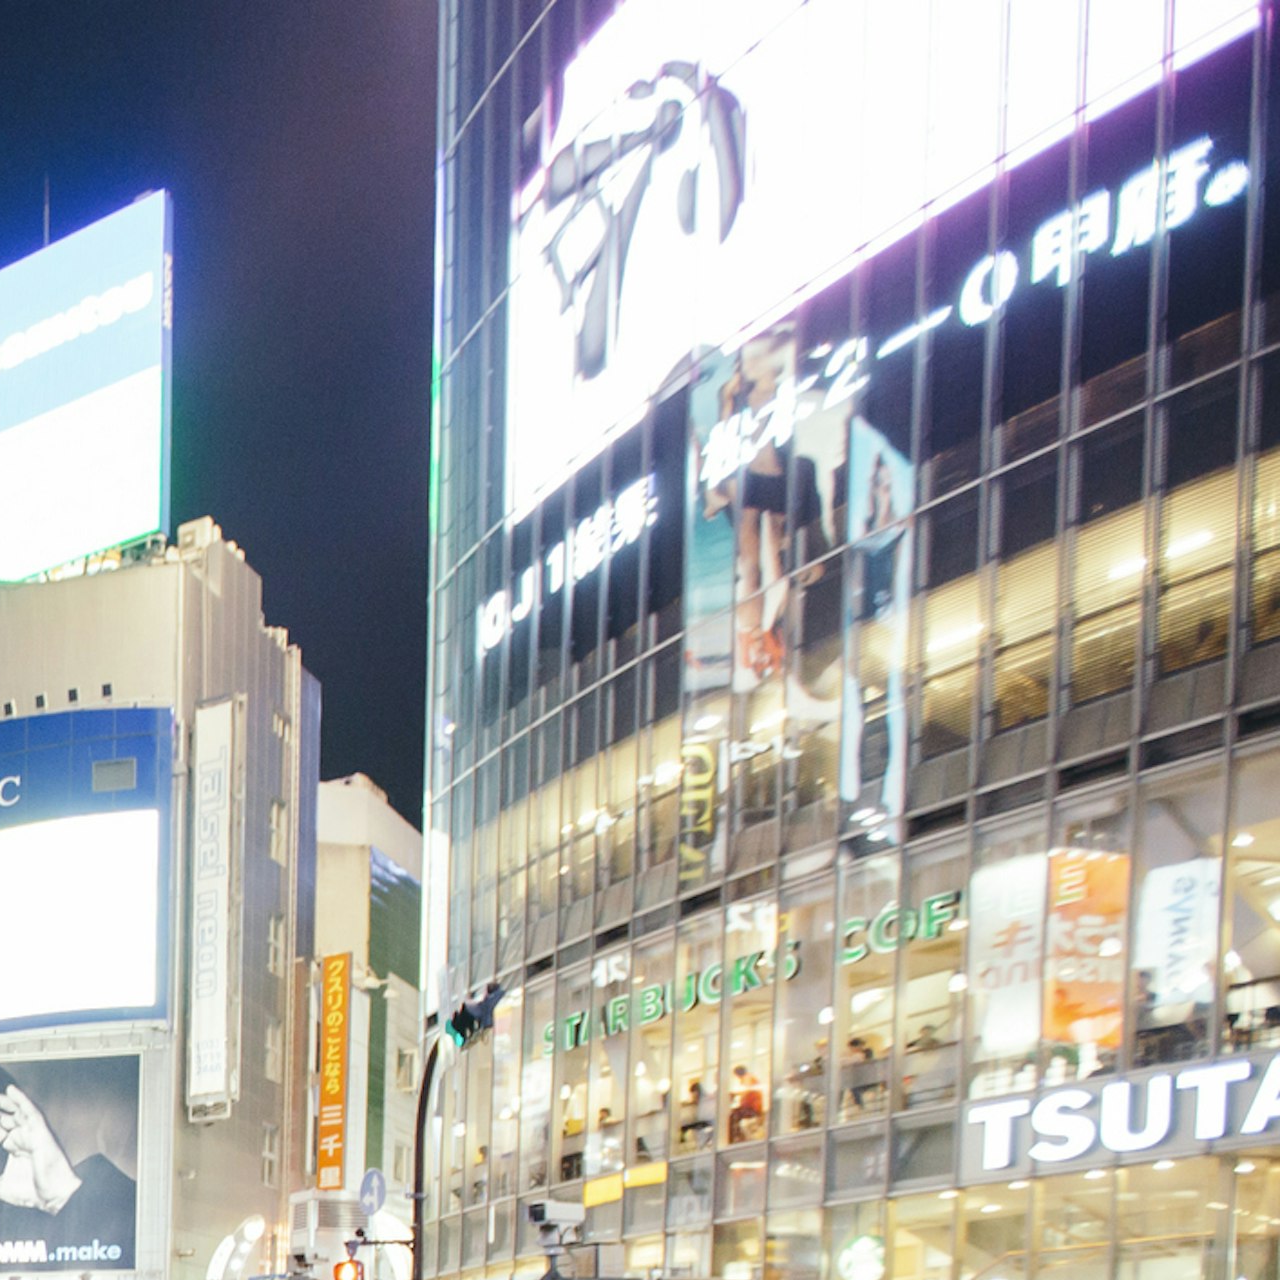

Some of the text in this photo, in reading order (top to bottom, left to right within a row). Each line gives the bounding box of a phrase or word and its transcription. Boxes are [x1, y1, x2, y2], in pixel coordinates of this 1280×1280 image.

[319, 959, 345, 1187] クスリのことなら 三千里
[543, 940, 801, 1058] STARBUCKS
